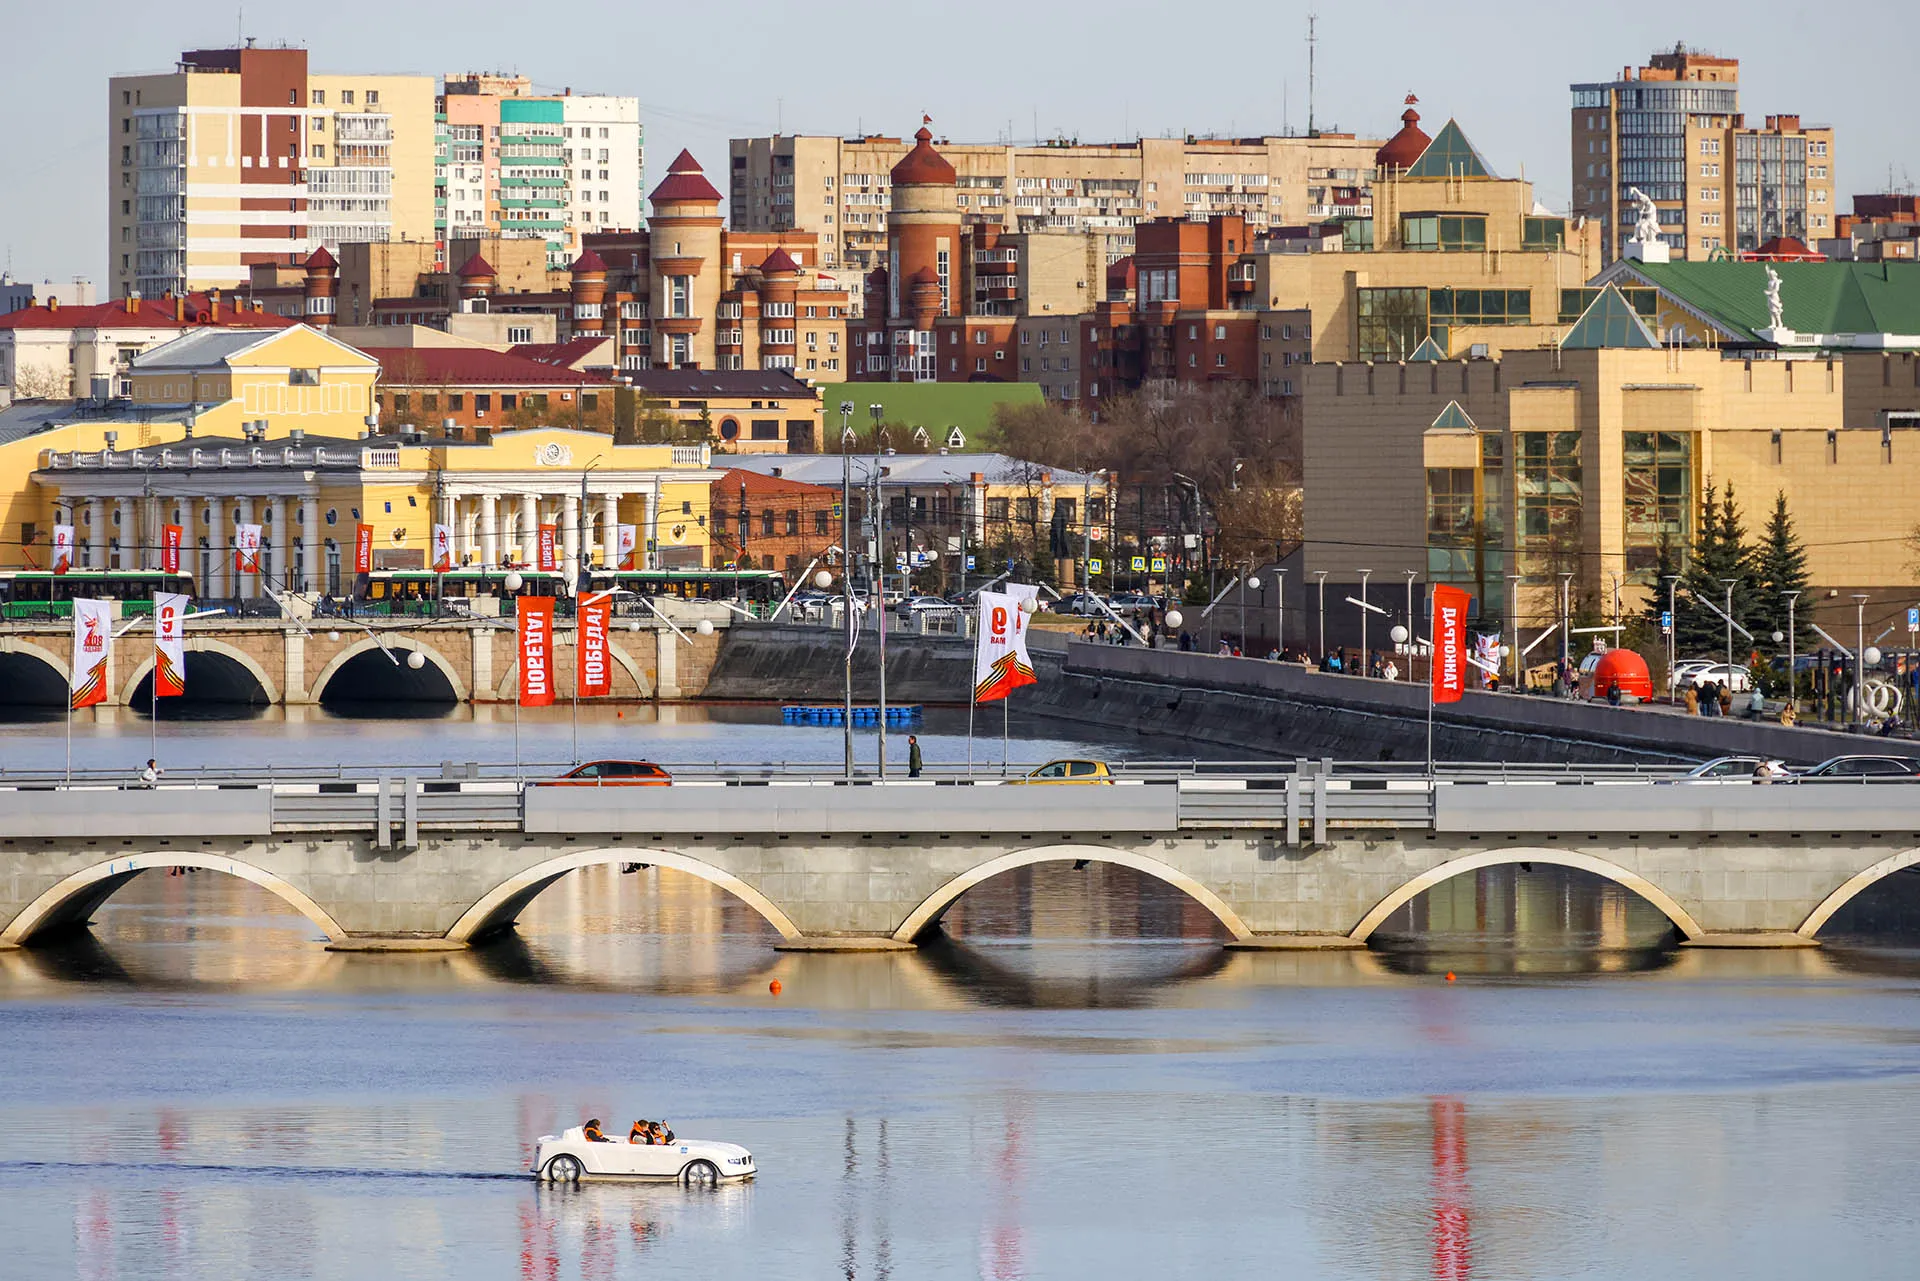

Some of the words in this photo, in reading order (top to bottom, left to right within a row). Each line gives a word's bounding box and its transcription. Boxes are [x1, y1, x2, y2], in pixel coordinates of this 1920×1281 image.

[161, 606, 175, 633] 9
[1910, 610, 1917, 623] P
[585, 608, 604, 685] ПОБЕДА!
